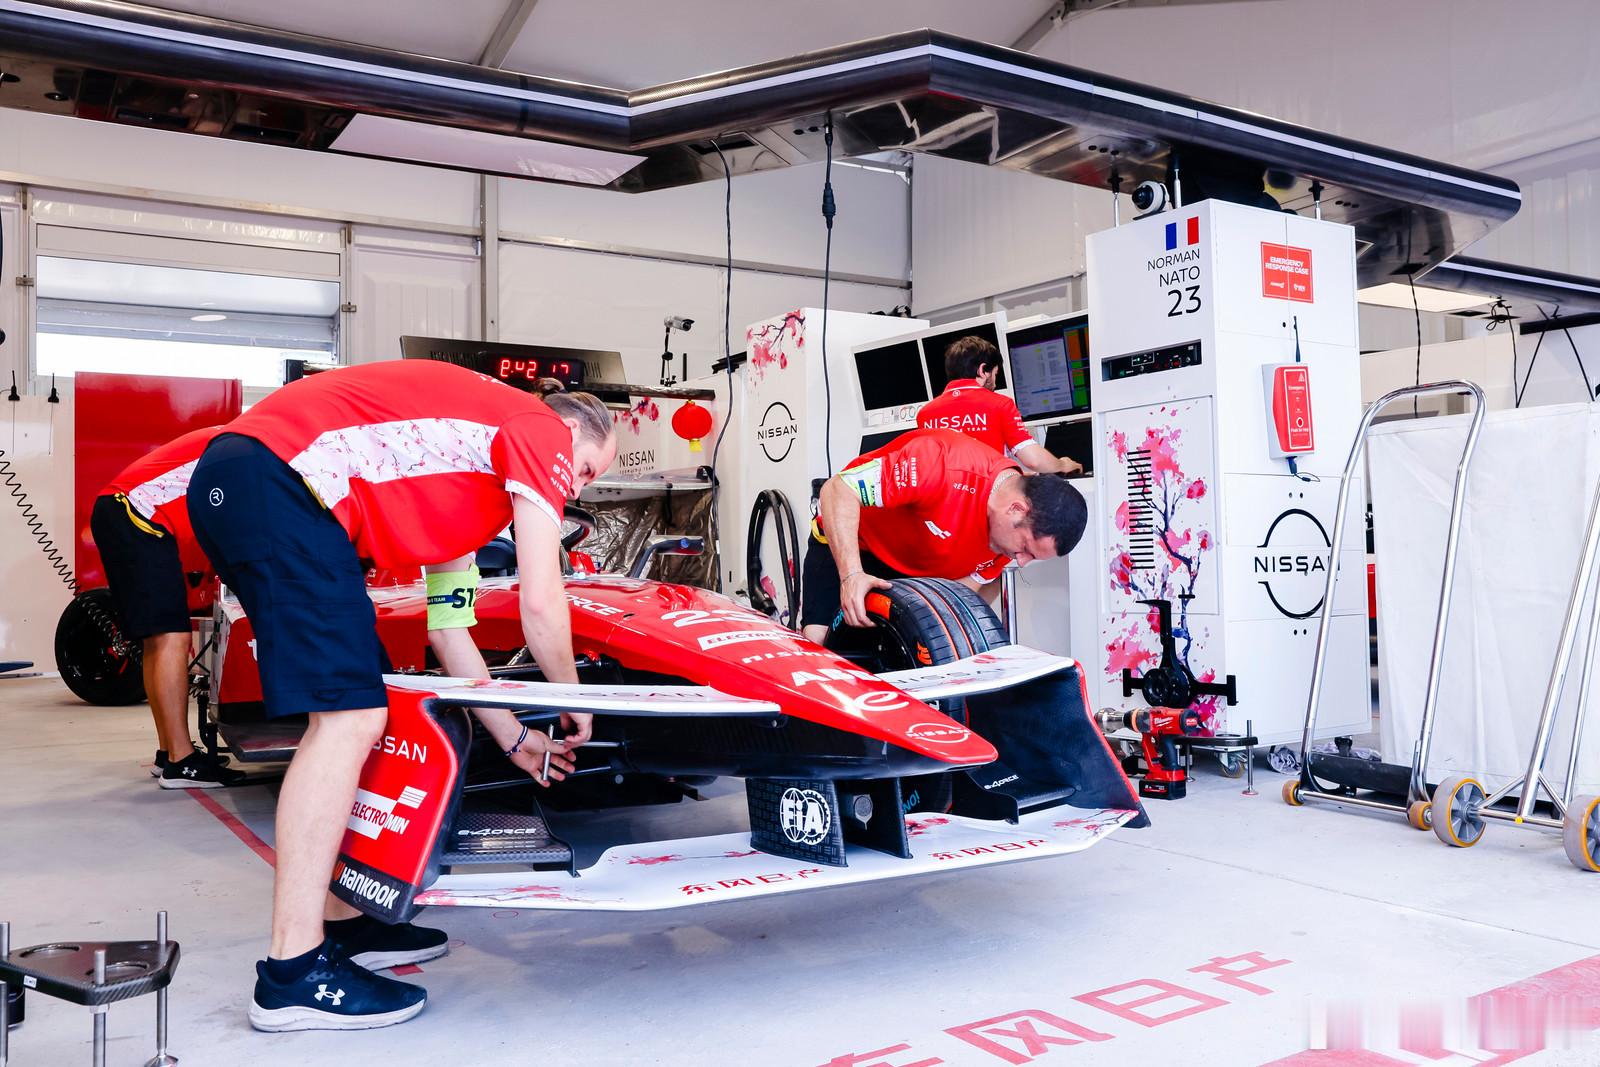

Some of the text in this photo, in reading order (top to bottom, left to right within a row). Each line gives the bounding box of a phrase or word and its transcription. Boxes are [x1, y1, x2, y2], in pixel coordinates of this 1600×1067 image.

[1147, 248, 1200, 272] NORMAN
[1265, 262, 1309, 275] RESPONSE CASE
[1269, 256, 1304, 267] EMERGENCY
[1159, 265, 1200, 288] NATO
[1167, 284, 1202, 317] 23
[923, 412, 987, 429] NISSAN
[757, 424, 798, 440] NISSAN
[619, 449, 655, 468] NISSAN
[905, 729, 972, 738] NISSAN
[929, 839, 1048, 860] 东风日产
[678, 868, 825, 895] 东风日产
